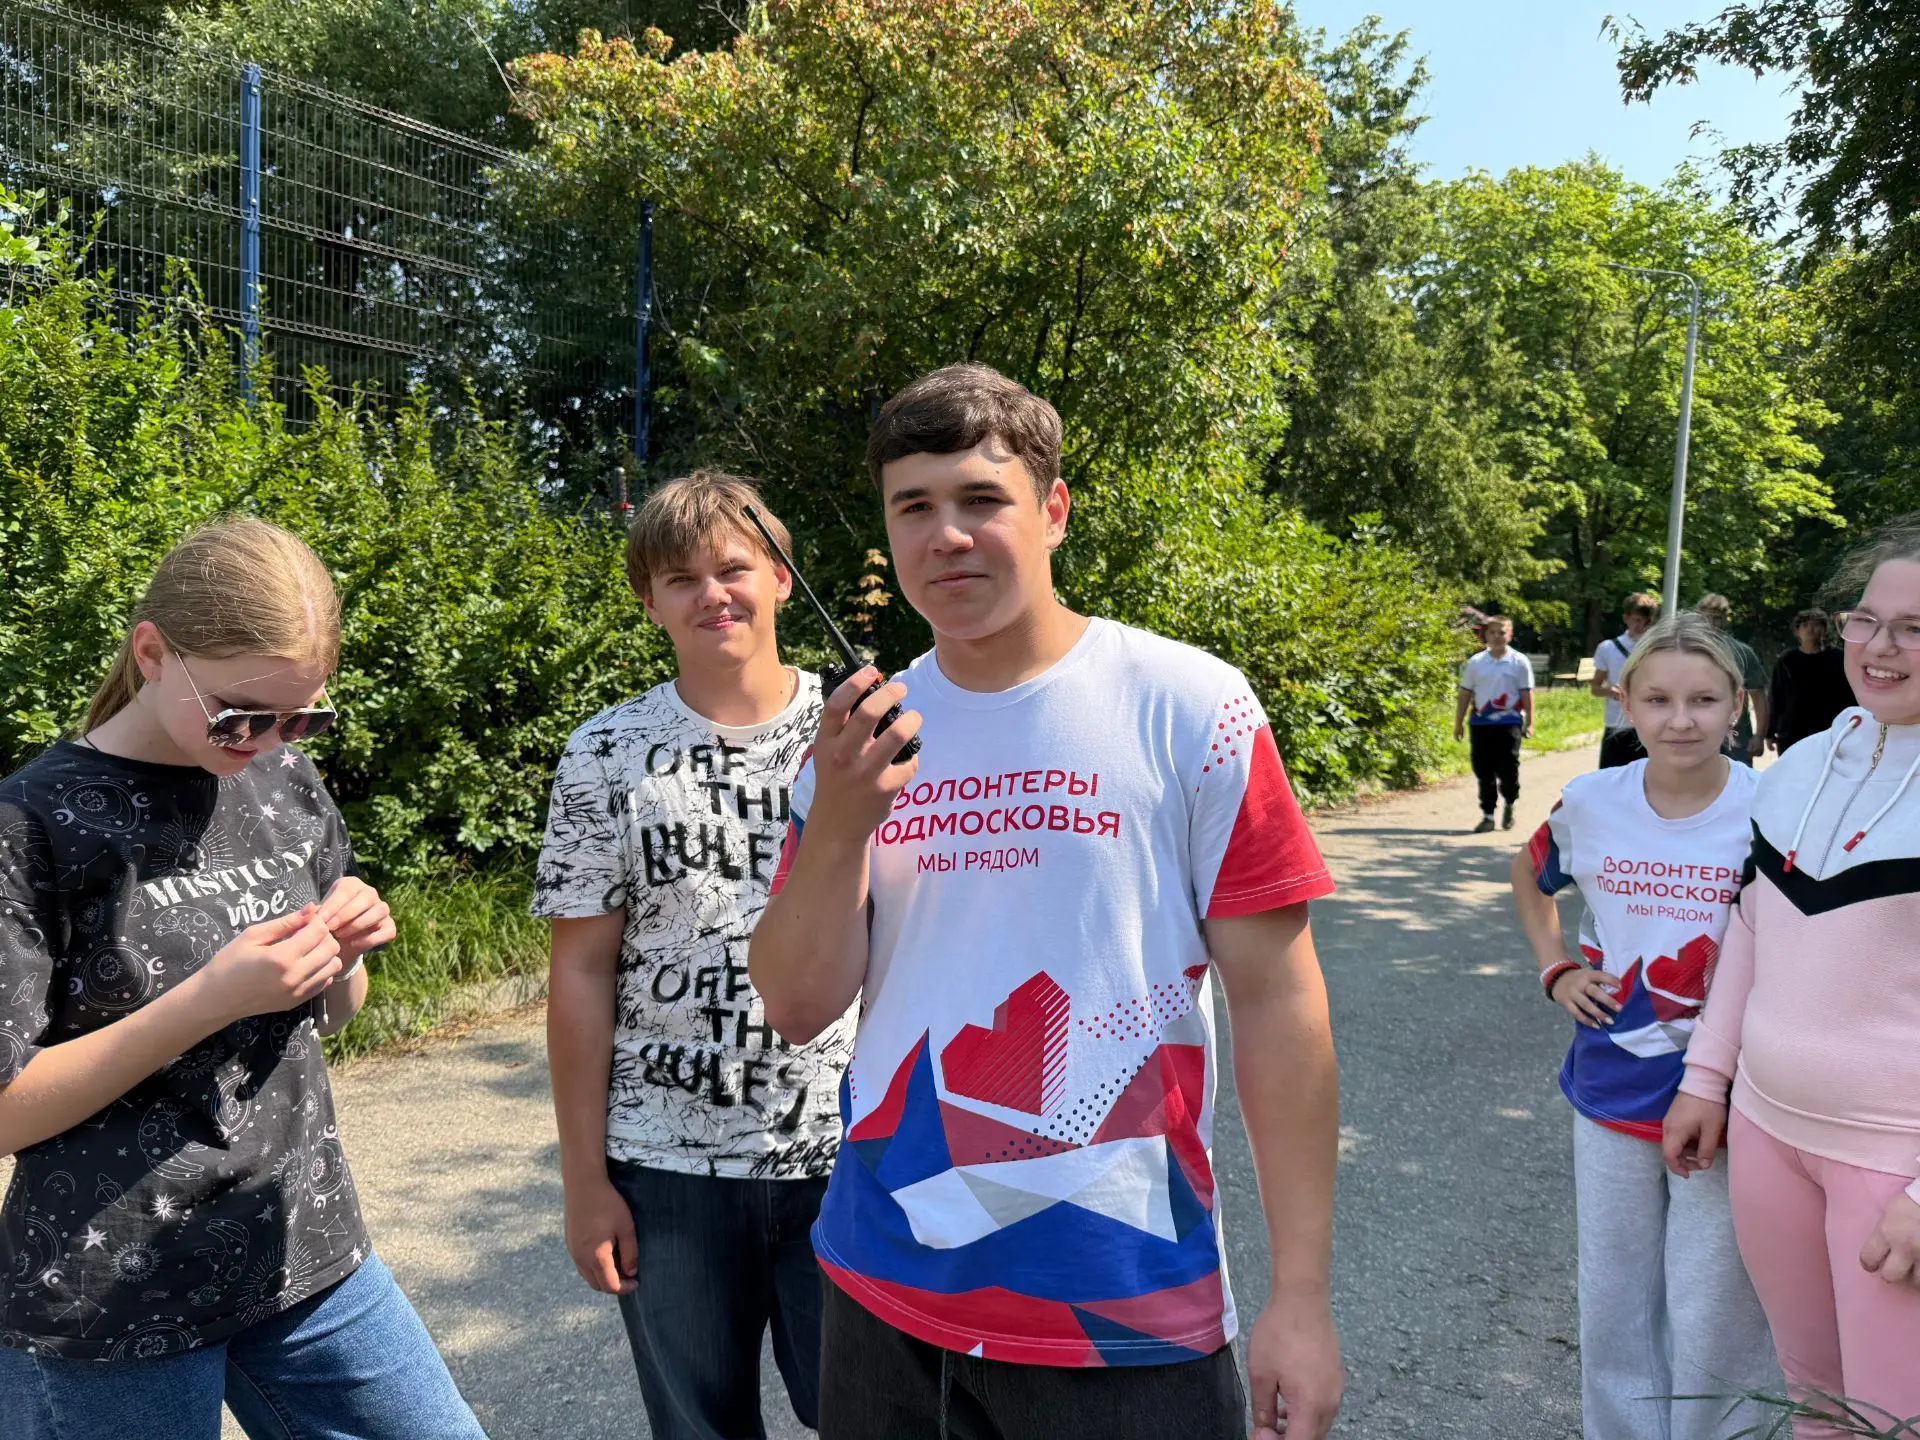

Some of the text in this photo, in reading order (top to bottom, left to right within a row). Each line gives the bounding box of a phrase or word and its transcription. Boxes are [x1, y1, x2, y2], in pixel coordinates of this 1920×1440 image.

[641, 821, 785, 886] RULE
[918, 847, 1039, 873] МЫ РЯДОМ
[226, 887, 288, 926] vibe
[1626, 903, 1713, 924] МЫ РЯДОМ
[700, 1008, 790, 1052] TH
